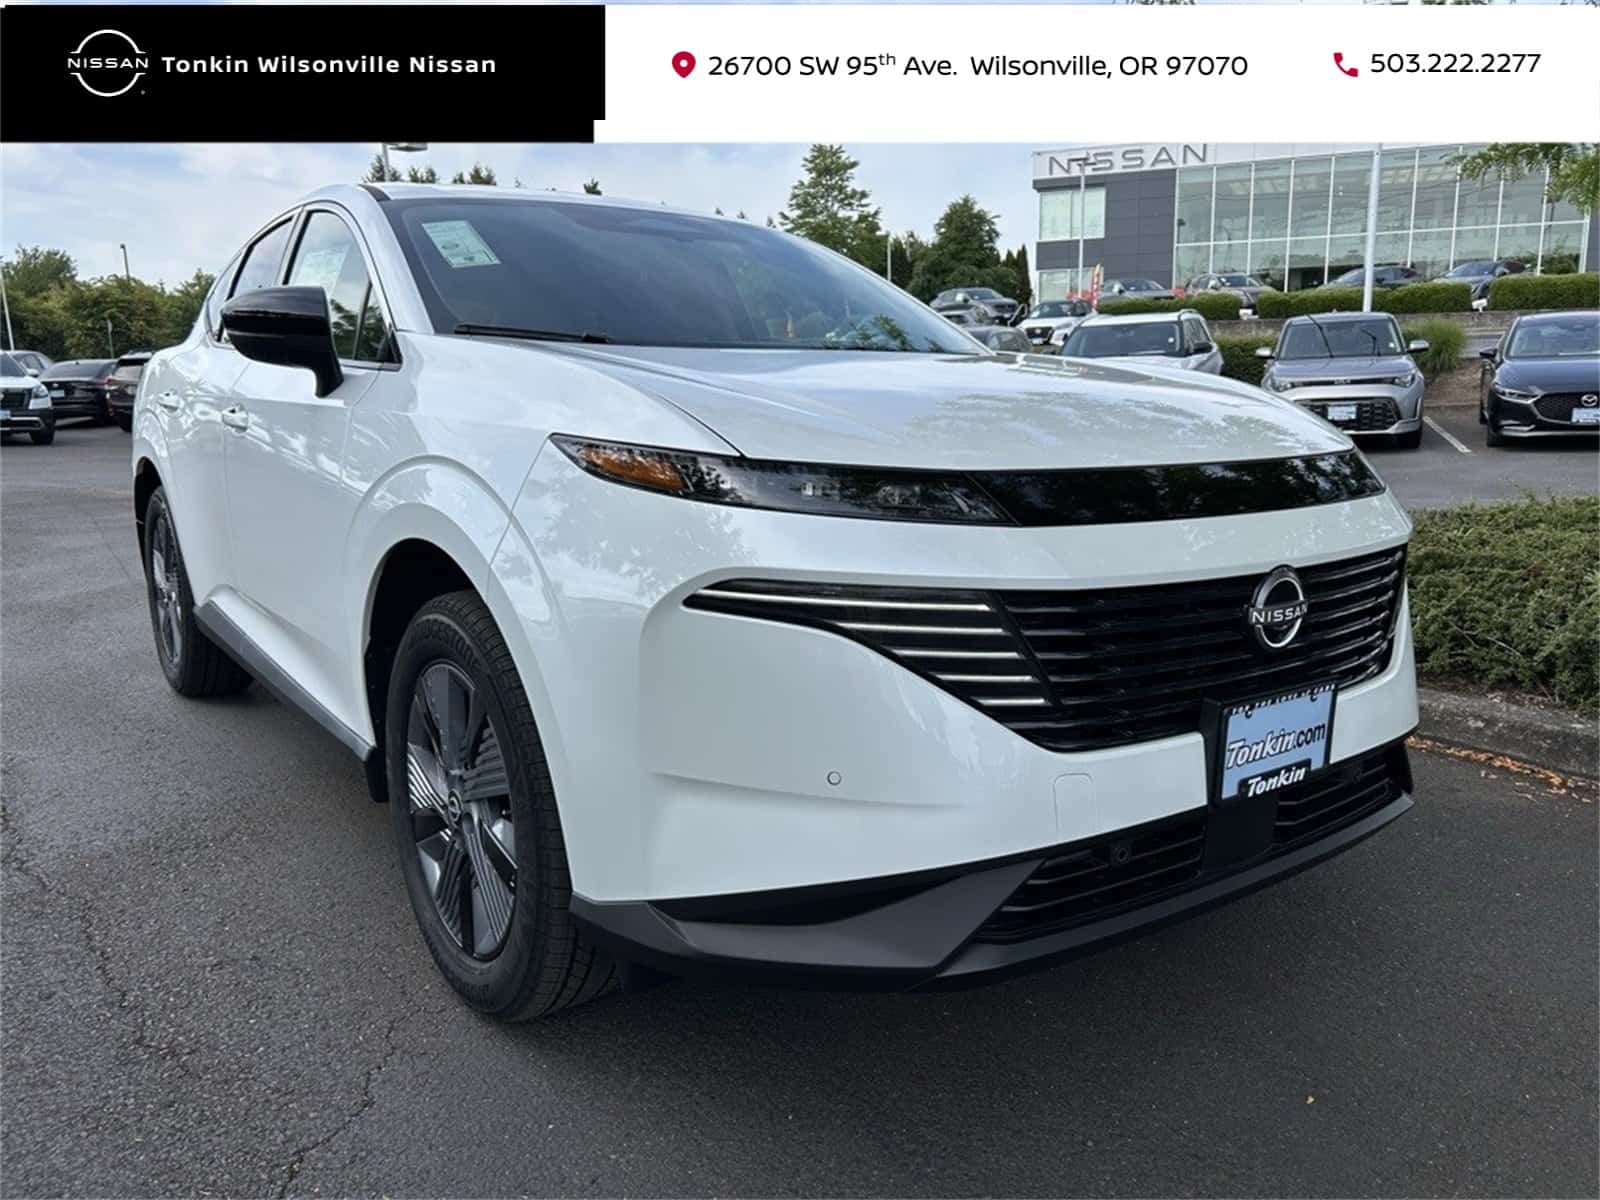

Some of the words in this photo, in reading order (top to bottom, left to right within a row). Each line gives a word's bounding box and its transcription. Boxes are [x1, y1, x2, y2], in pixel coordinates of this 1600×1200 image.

[1251, 603, 1308, 624] NISSAN
[1226, 722, 1327, 770] Tonkin.com
[1247, 766, 1307, 798] Tonkin
